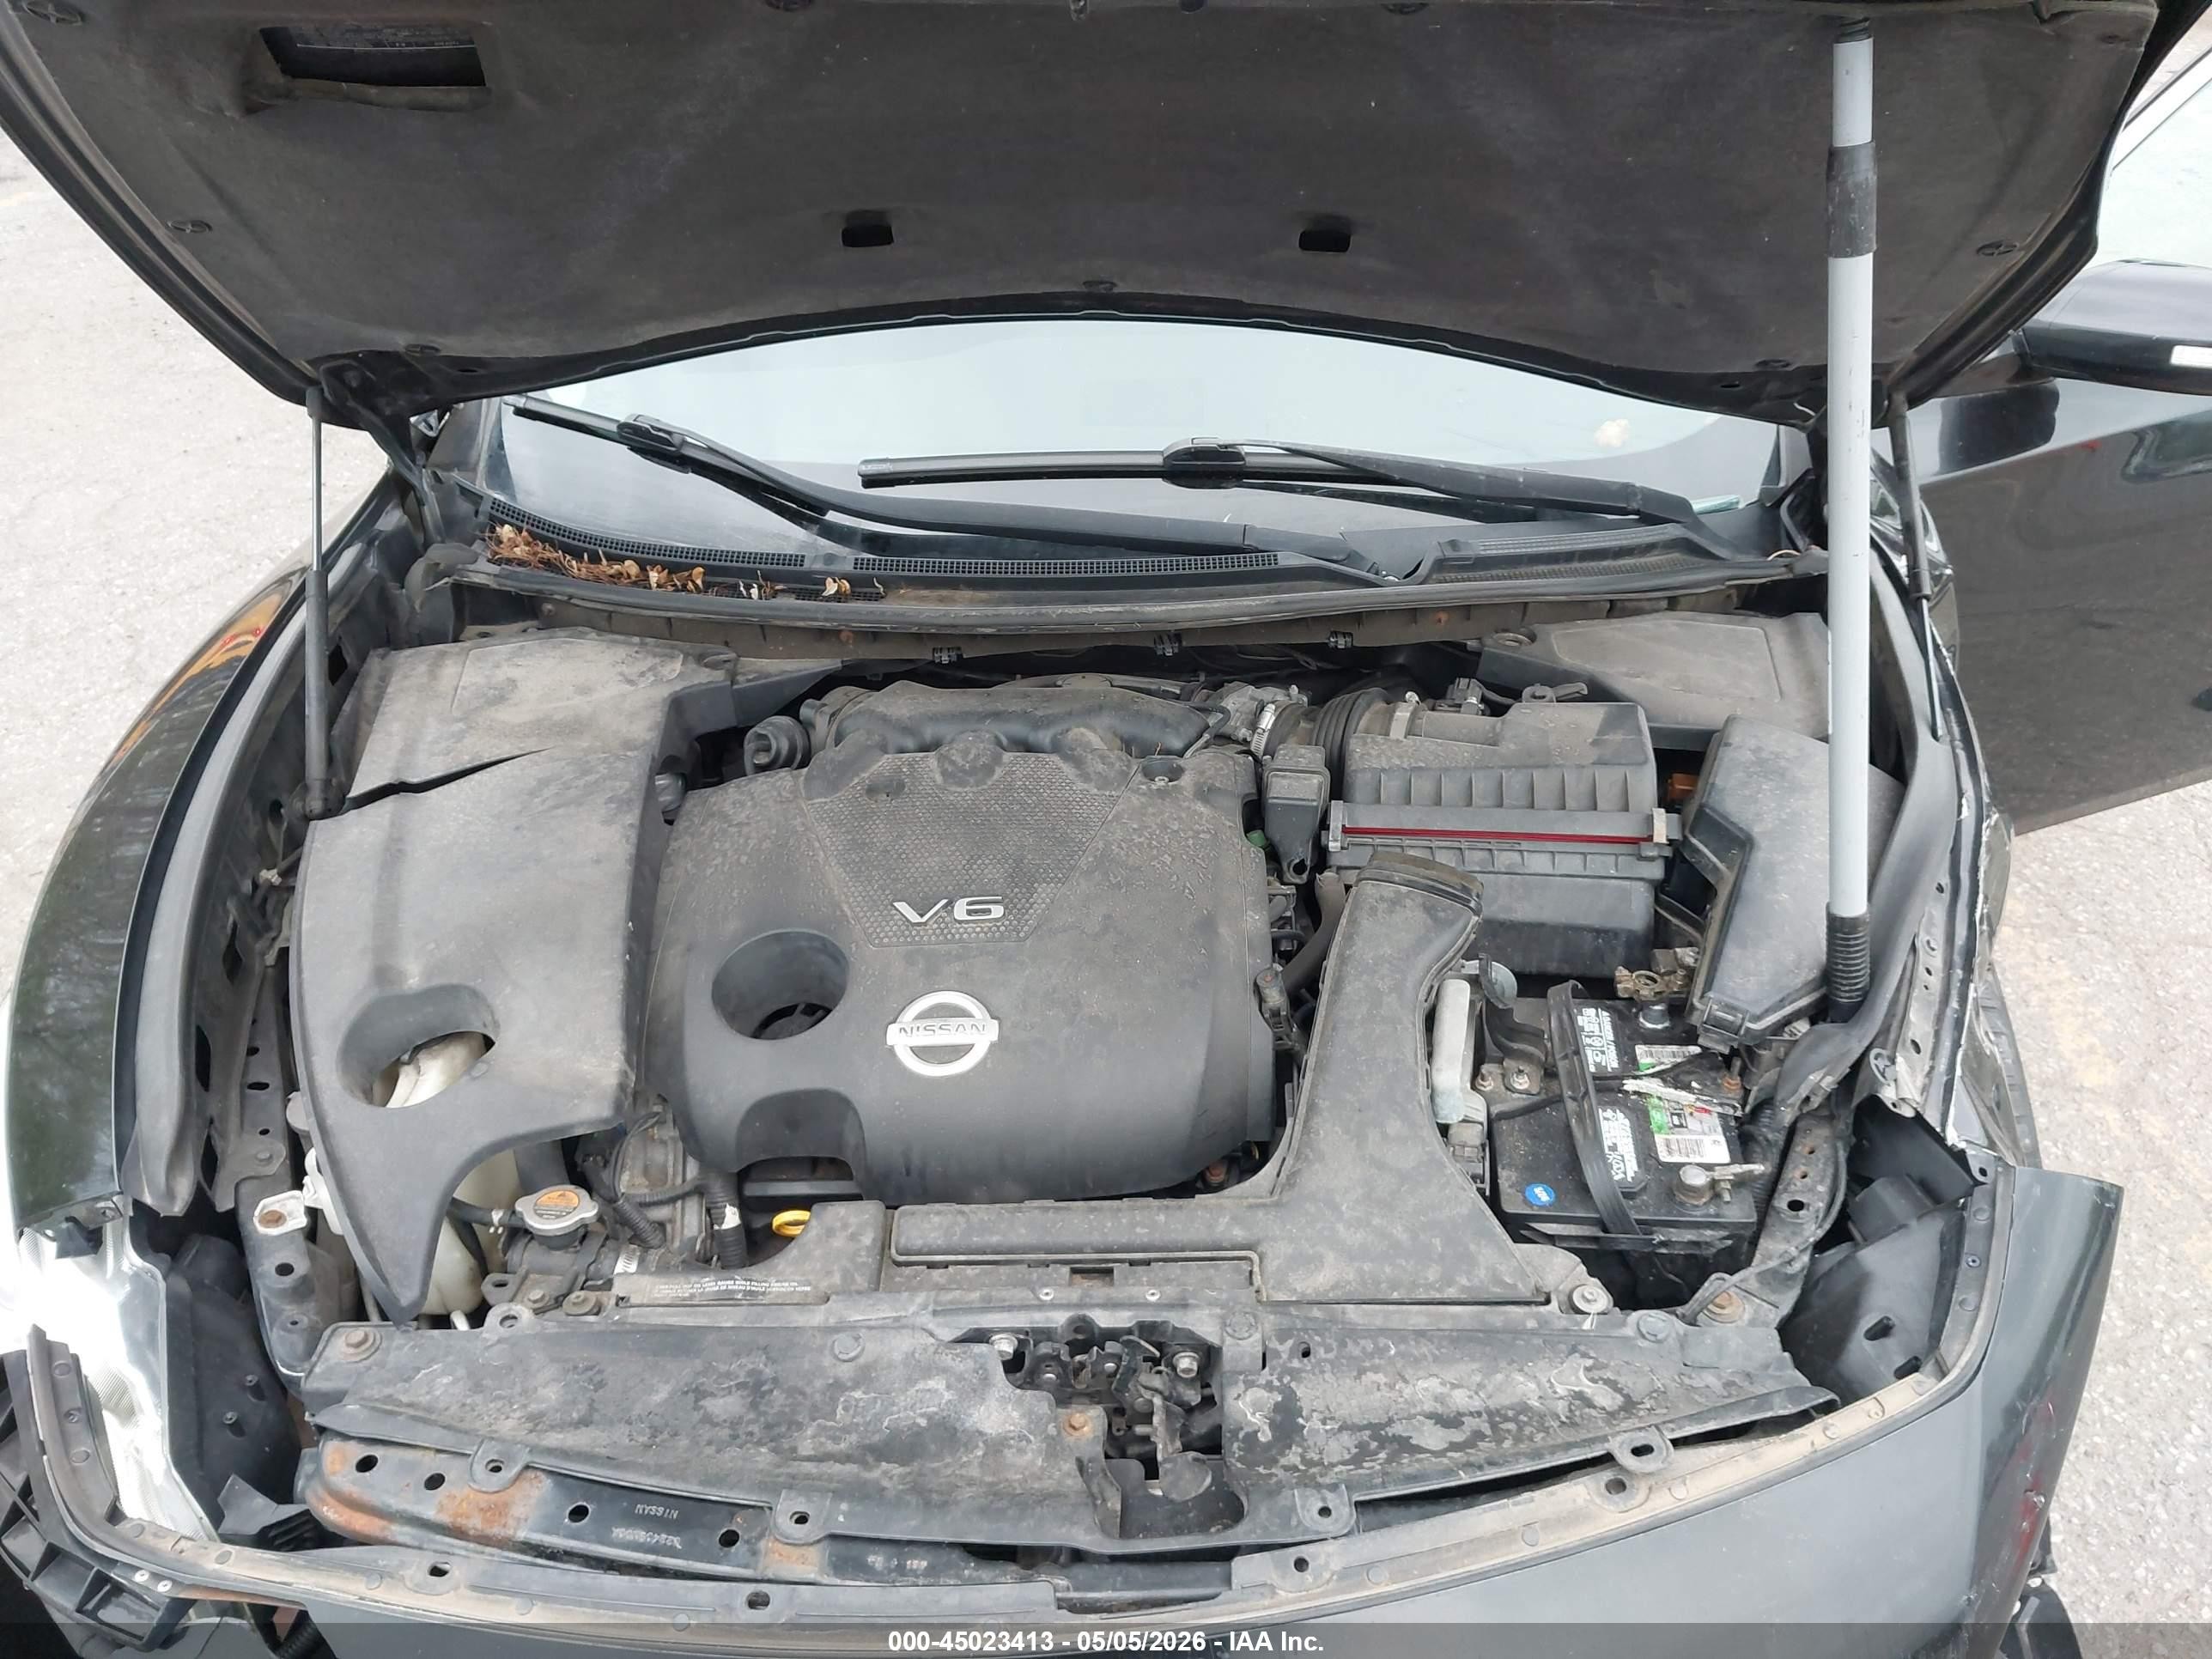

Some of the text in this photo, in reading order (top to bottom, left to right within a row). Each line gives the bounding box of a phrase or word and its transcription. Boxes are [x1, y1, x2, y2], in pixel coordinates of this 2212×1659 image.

[892, 896, 1005, 923] V6
[899, 1023, 986, 1037] NISSAN
[635, 1504, 678, 1519] NISSAN
